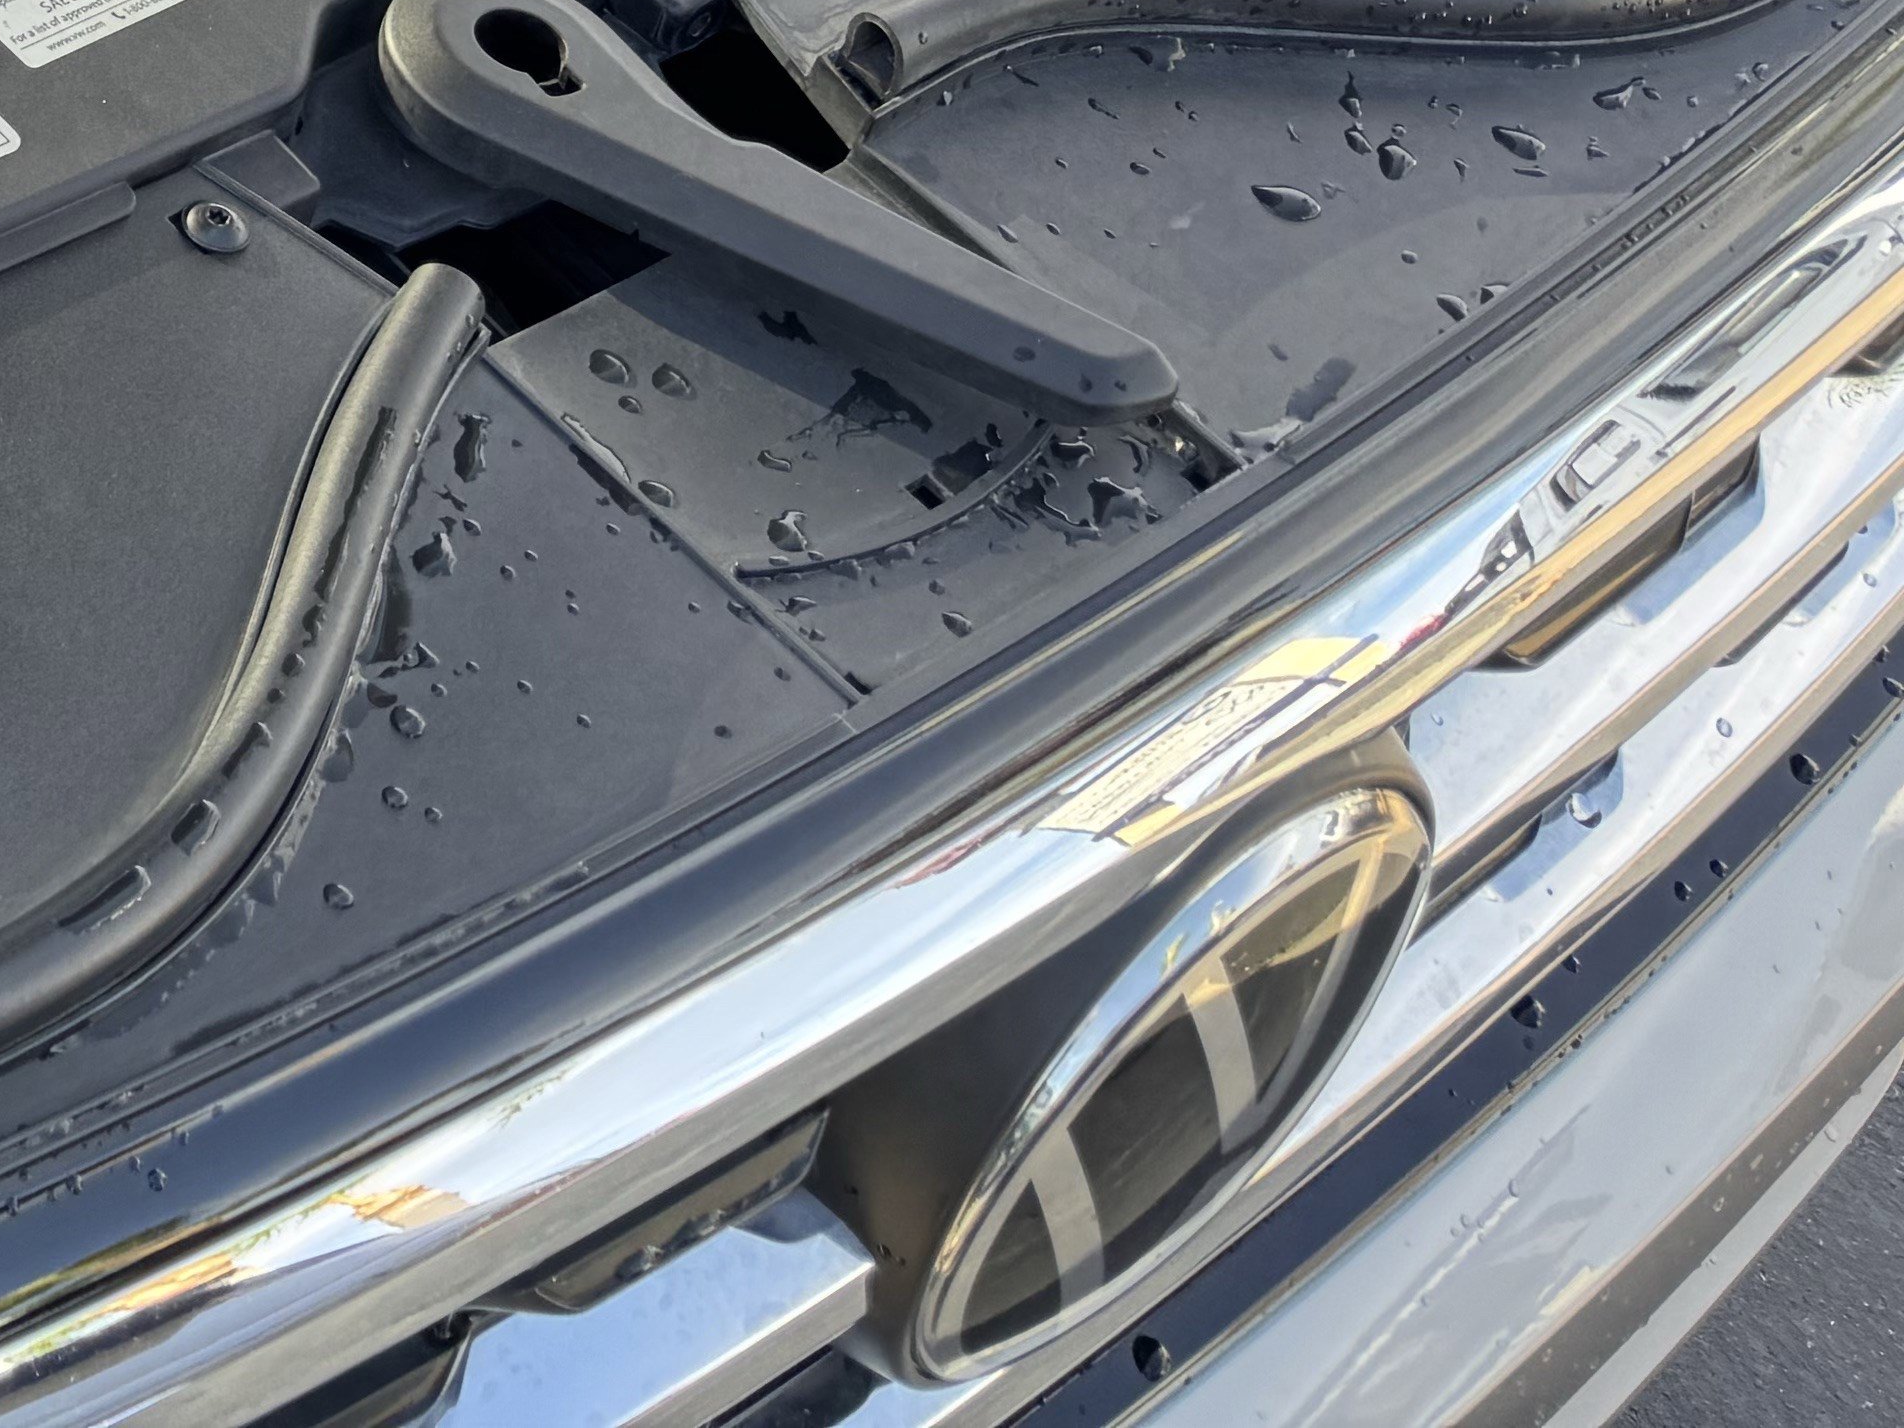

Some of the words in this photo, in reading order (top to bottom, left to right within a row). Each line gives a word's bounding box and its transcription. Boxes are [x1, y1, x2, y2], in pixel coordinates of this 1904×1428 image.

[9, 32, 27, 44] For
[31, 21, 51, 33] list
[49, 15, 61, 27] of
